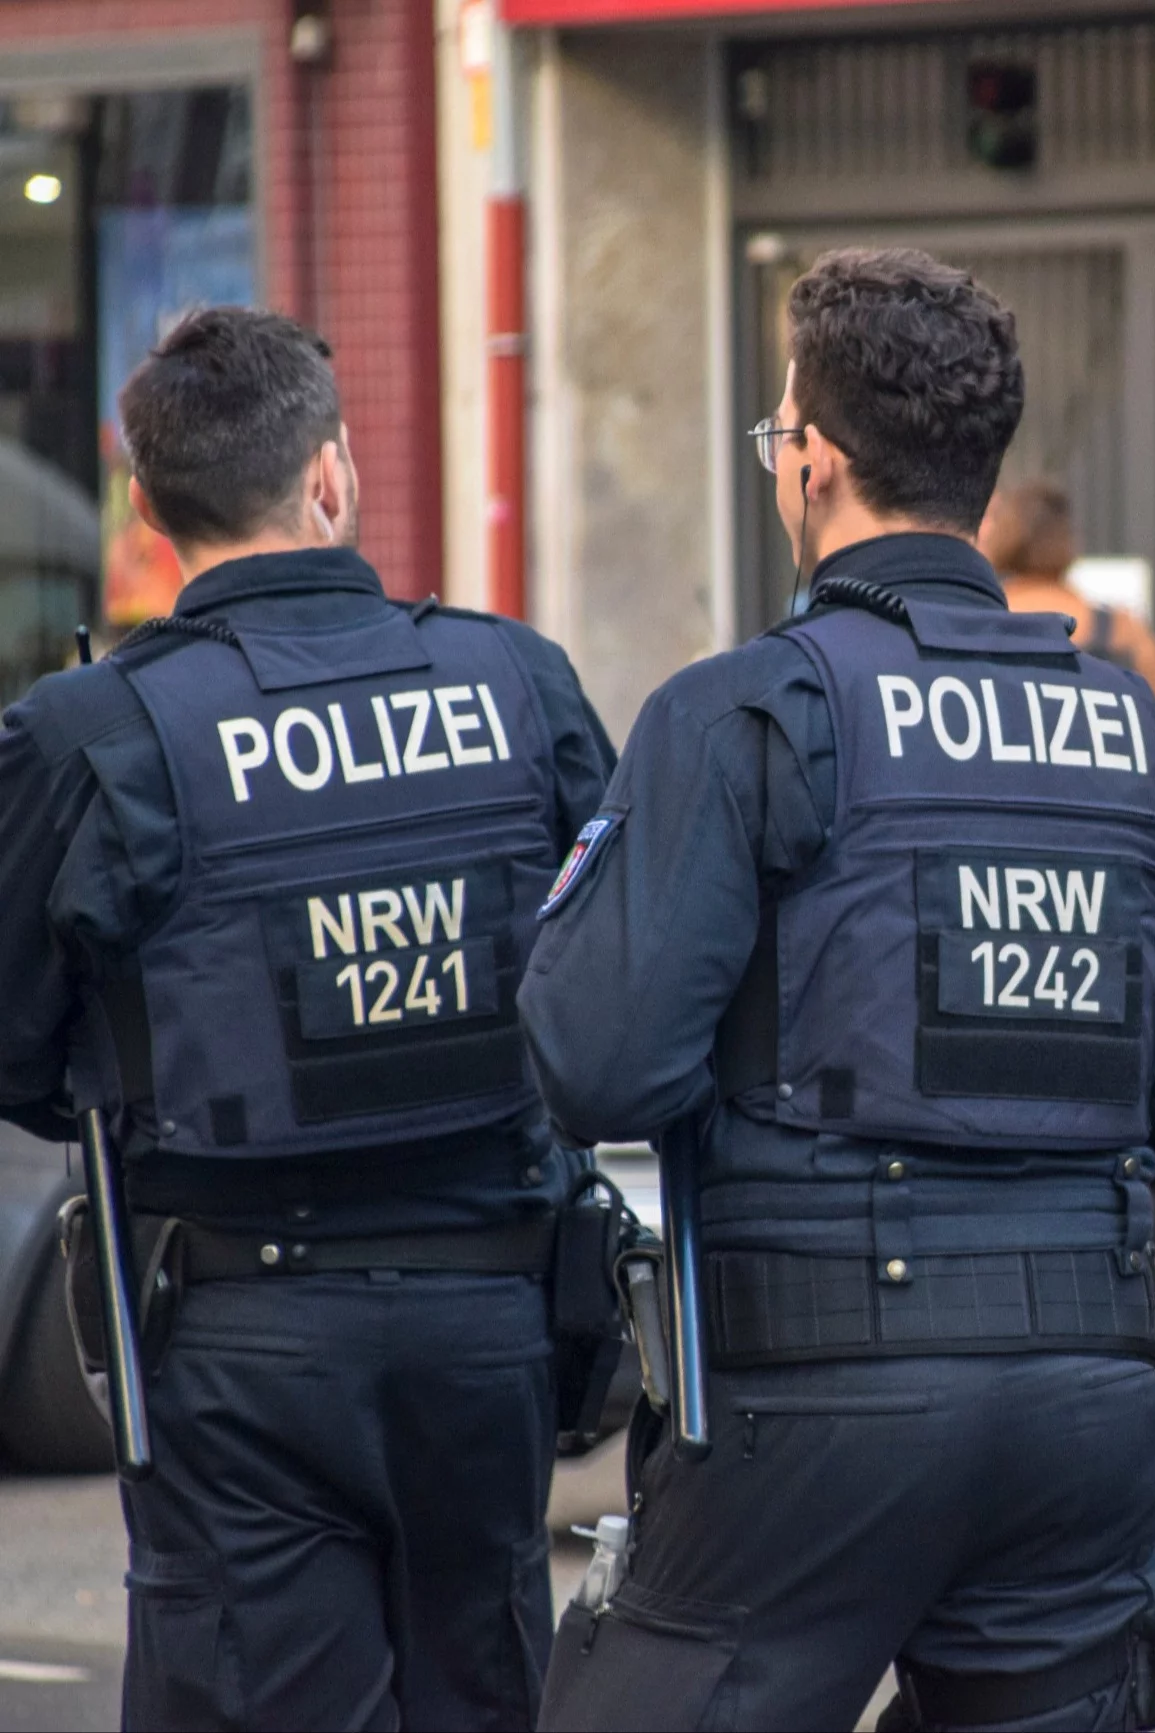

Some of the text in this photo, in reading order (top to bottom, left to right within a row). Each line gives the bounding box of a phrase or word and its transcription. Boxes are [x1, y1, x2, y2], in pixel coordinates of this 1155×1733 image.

[217, 683, 511, 803] POLIZEI
[877, 674, 1148, 775] POLIZEI
[306, 877, 466, 960] NRW
[957, 864, 1106, 935] NRW
[335, 949, 468, 1026] 1241
[971, 940, 1101, 1014] 1242
